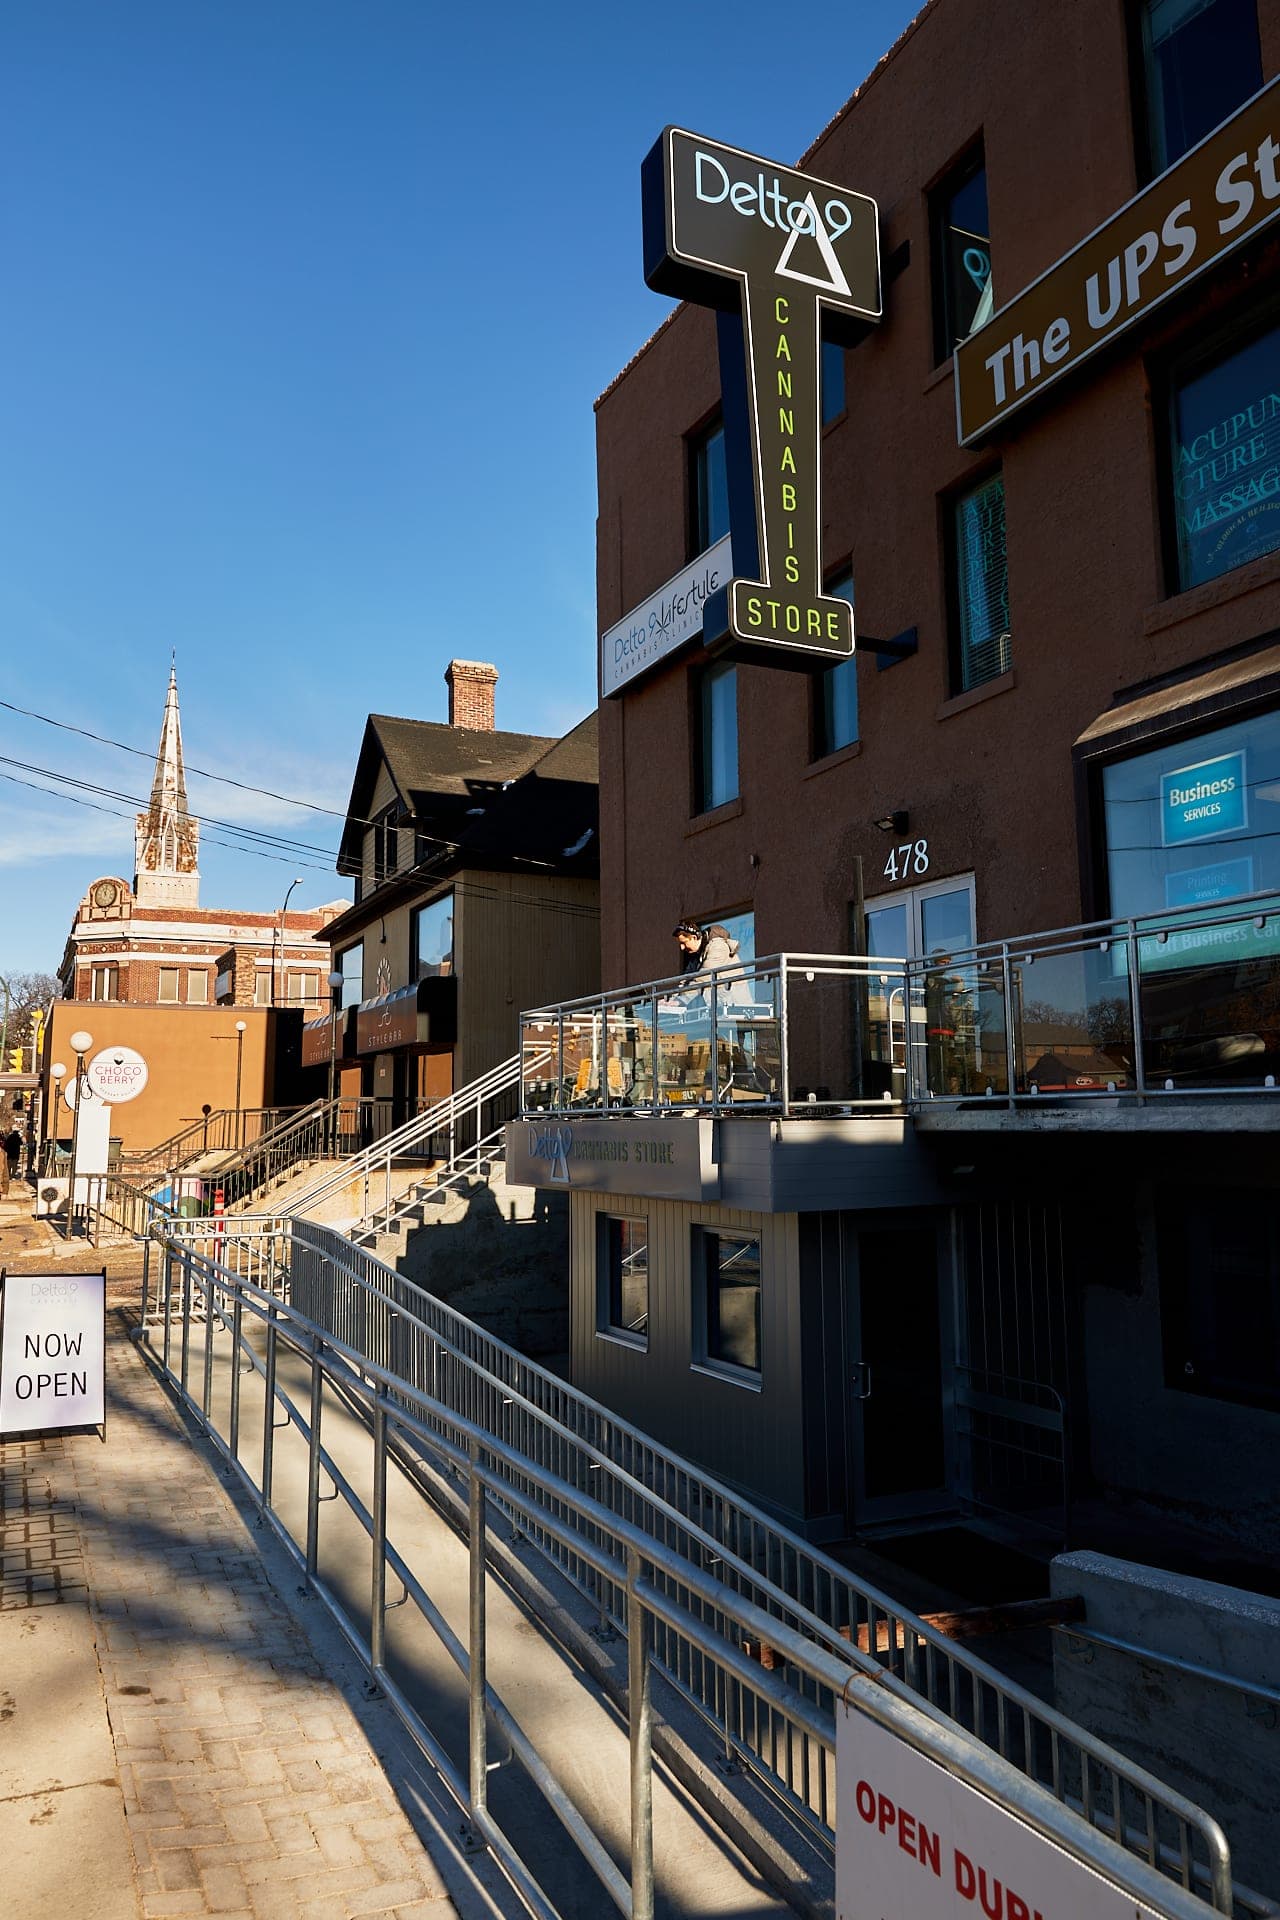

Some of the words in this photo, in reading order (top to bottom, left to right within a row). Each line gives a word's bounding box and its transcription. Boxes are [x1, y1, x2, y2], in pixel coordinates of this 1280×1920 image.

[985, 316, 1071, 406] The
[1085, 199, 1197, 330] UPS
[774, 297, 801, 584] CANNABIS
[1178, 432, 1268, 501] CTURE
[748, 597, 839, 641] STORE
[614, 627, 647, 664] Delta
[649, 612, 657, 638] 9
[614, 641, 657, 679] CANNABIS
[1169, 776, 1236, 807] Business
[1183, 802, 1221, 823] SERVICES
[883, 839, 930, 882] 478
[1182, 925, 1248, 949] Business
[95, 1066, 141, 1076] CHOCO
[100, 1075, 135, 1085] BERRY
[634, 1142, 675, 1165] STORE
[31, 1283, 67, 1297] Delta
[69, 1283, 79, 1296] 9
[24, 1332, 83, 1359] NOW
[15, 1371, 87, 1400] OPEN
[855, 1780, 942, 1878] OPEN
[954, 1849, 1043, 1920] DUR
